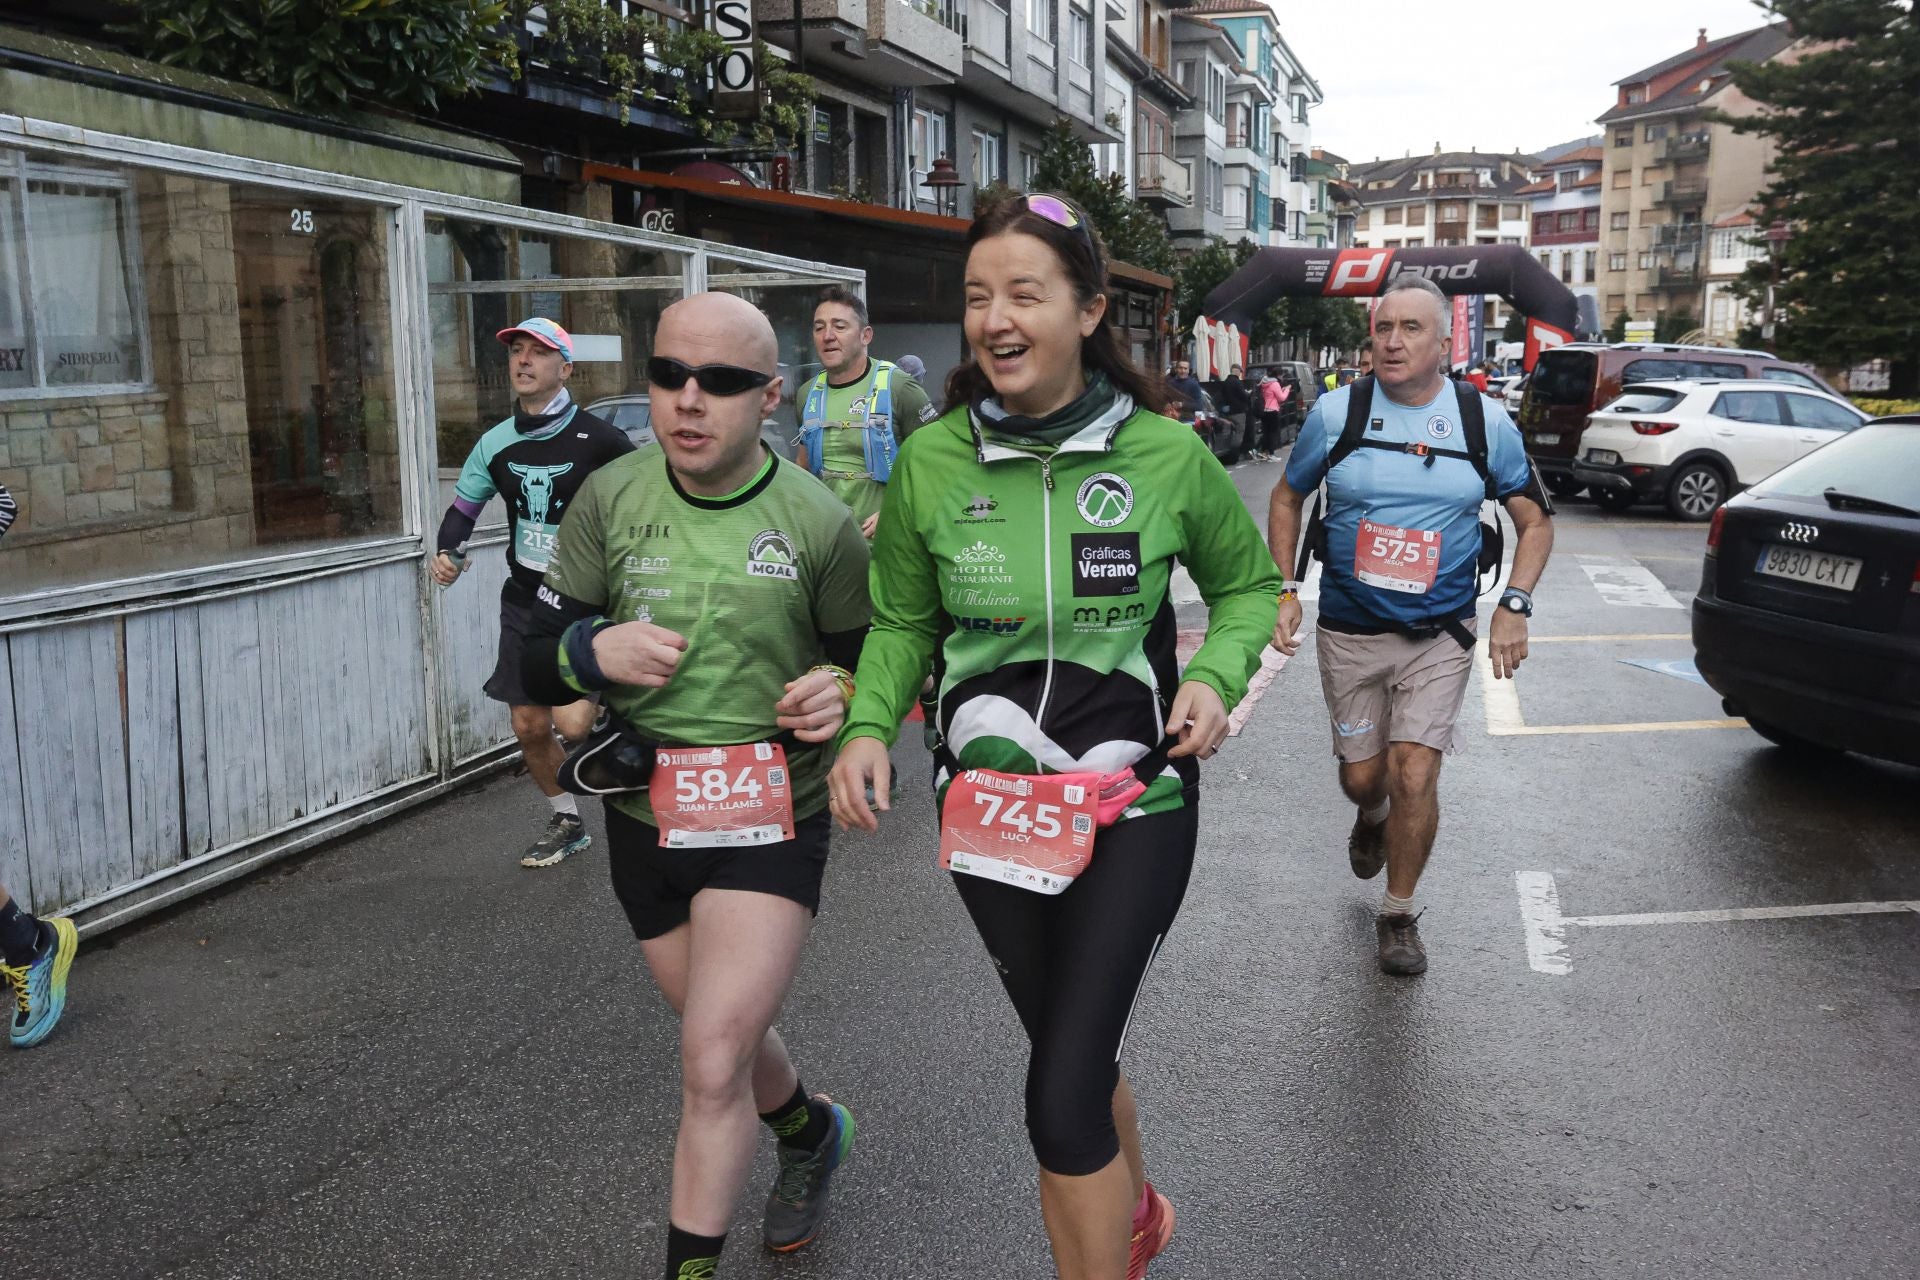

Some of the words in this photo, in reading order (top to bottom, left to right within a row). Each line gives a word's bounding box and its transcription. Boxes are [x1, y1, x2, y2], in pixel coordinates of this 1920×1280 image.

[290, 208, 314, 233] 25
[522, 529, 555, 551] 213
[1370, 536, 1421, 563] 575
[1081, 546, 1132, 561] Gráficas
[752, 563, 793, 577] MOAL
[953, 565, 1008, 574] HOTEL
[1078, 560, 1137, 579] Verano
[1767, 548, 1812, 577] 9830
[1815, 557, 1855, 585] CXT
[950, 575, 1014, 584] RESTAURANTE
[964, 588, 1021, 607] Molinón
[675, 766, 763, 803] 584
[677, 803, 705, 812] JUAN
[708, 802, 718, 811] F.
[720, 799, 763, 810] LLAMES
[974, 791, 1062, 838] 745
[1001, 831, 1032, 843] LUCY
